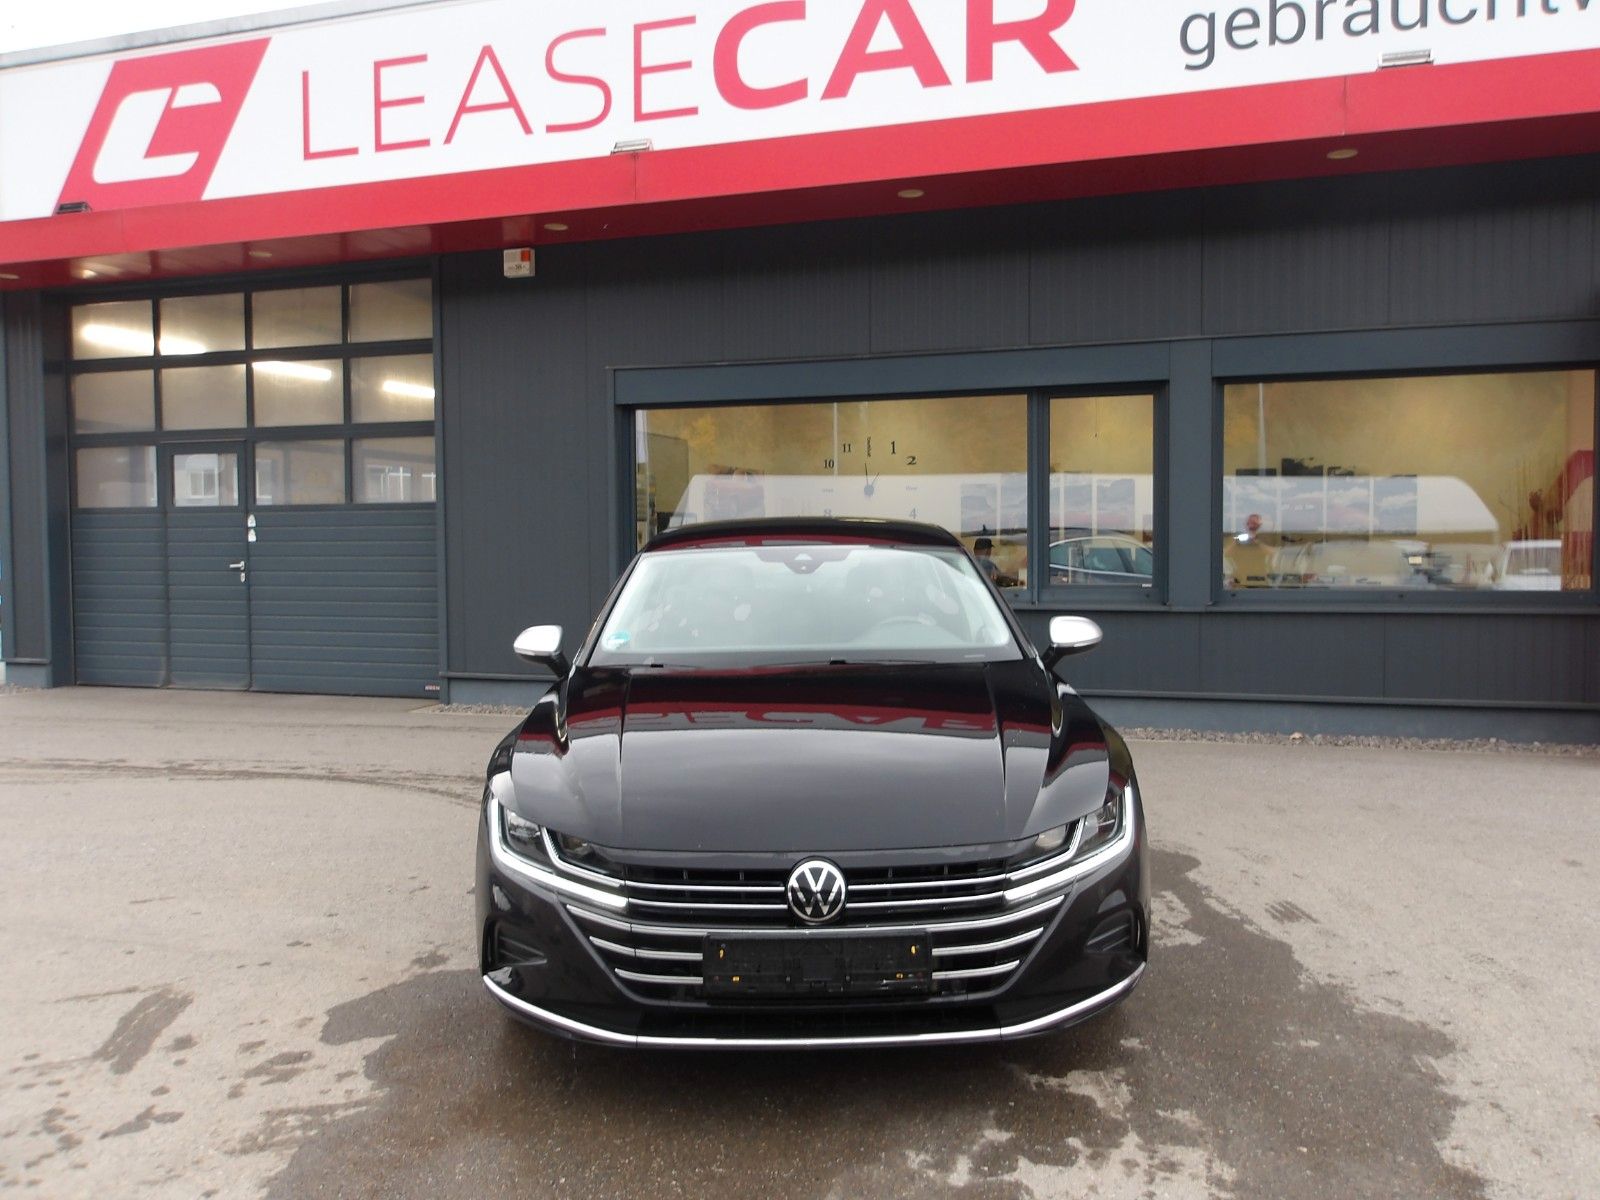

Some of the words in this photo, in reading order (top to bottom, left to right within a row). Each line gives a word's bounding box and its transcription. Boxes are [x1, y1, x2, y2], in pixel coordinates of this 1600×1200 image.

[1179, 0, 1600, 71] gebrauc
[302, 0, 1080, 161] LEASECAR
[842, 443, 852, 454] 11
[890, 440, 897, 455] 1
[823, 458, 835, 470] 10
[905, 455, 917, 466] 2
